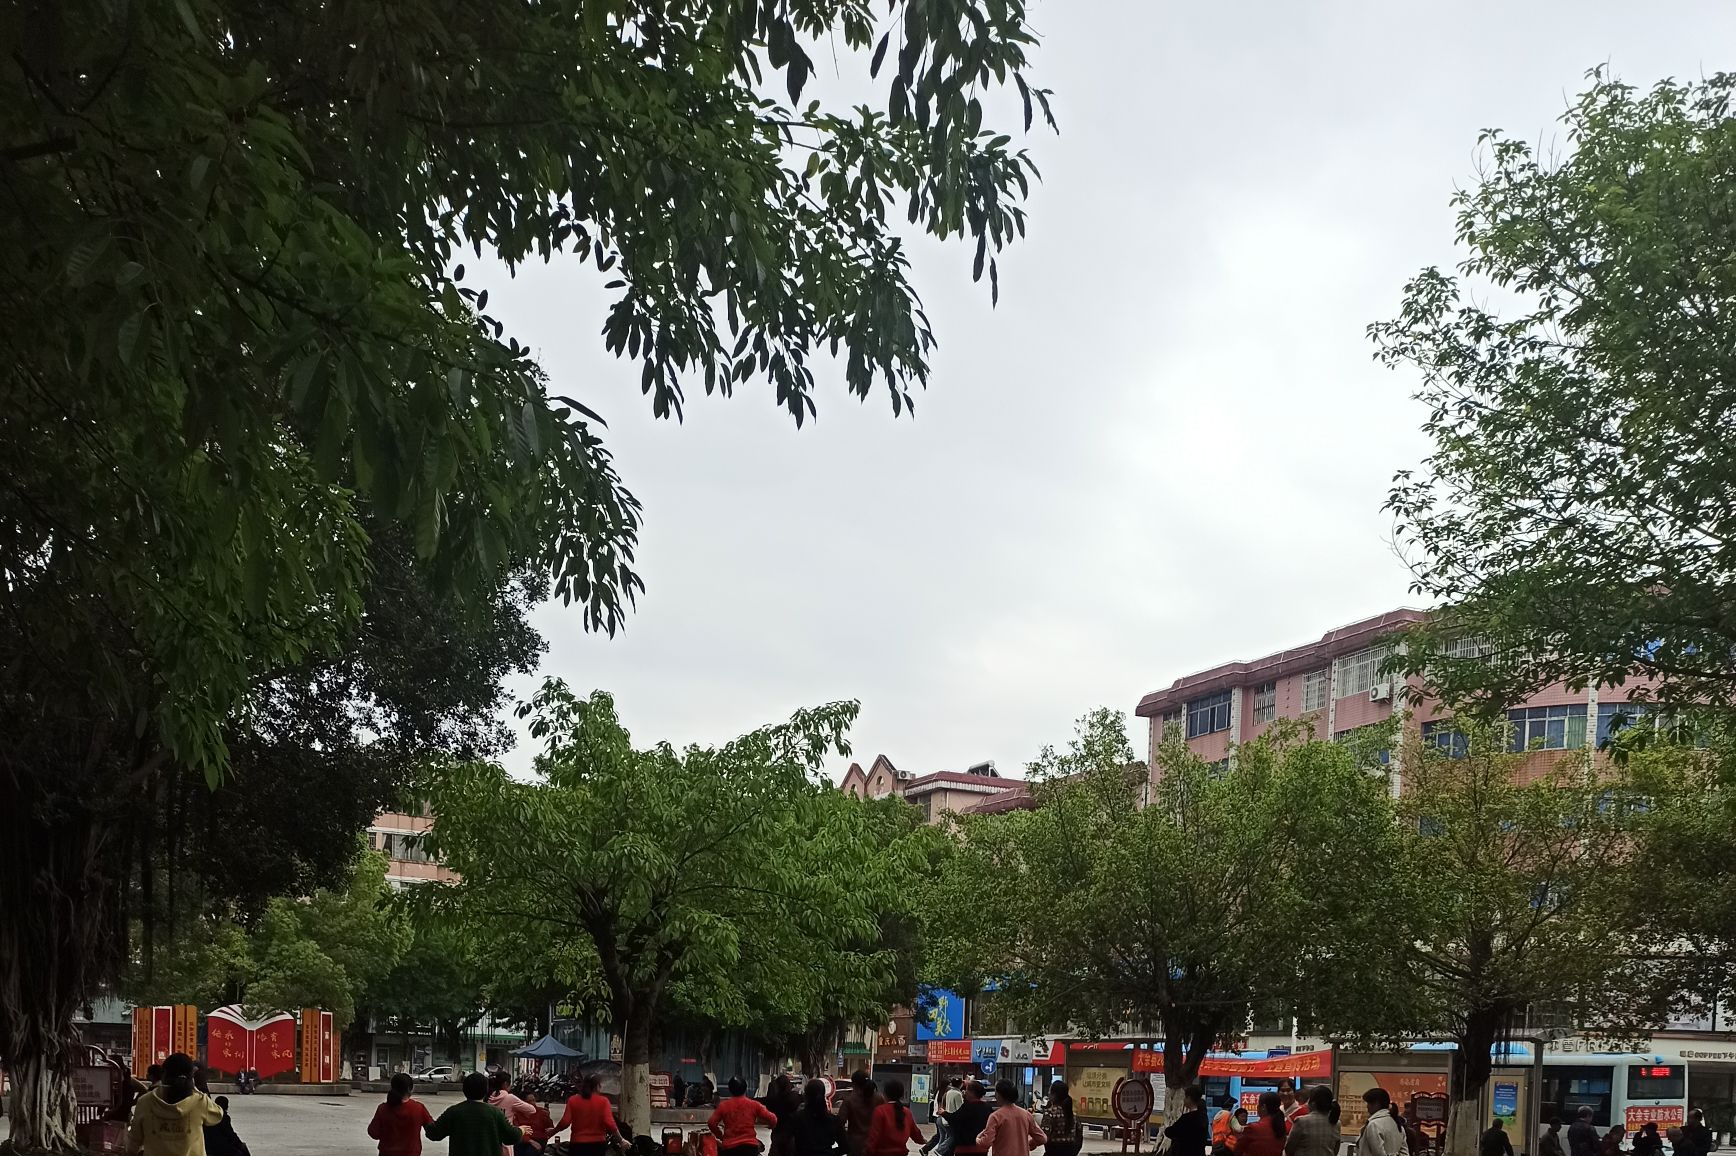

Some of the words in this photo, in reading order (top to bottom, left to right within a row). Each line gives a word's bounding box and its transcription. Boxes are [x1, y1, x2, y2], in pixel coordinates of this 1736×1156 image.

[1628, 1109, 1683, 1121] 大余专业防水公司
